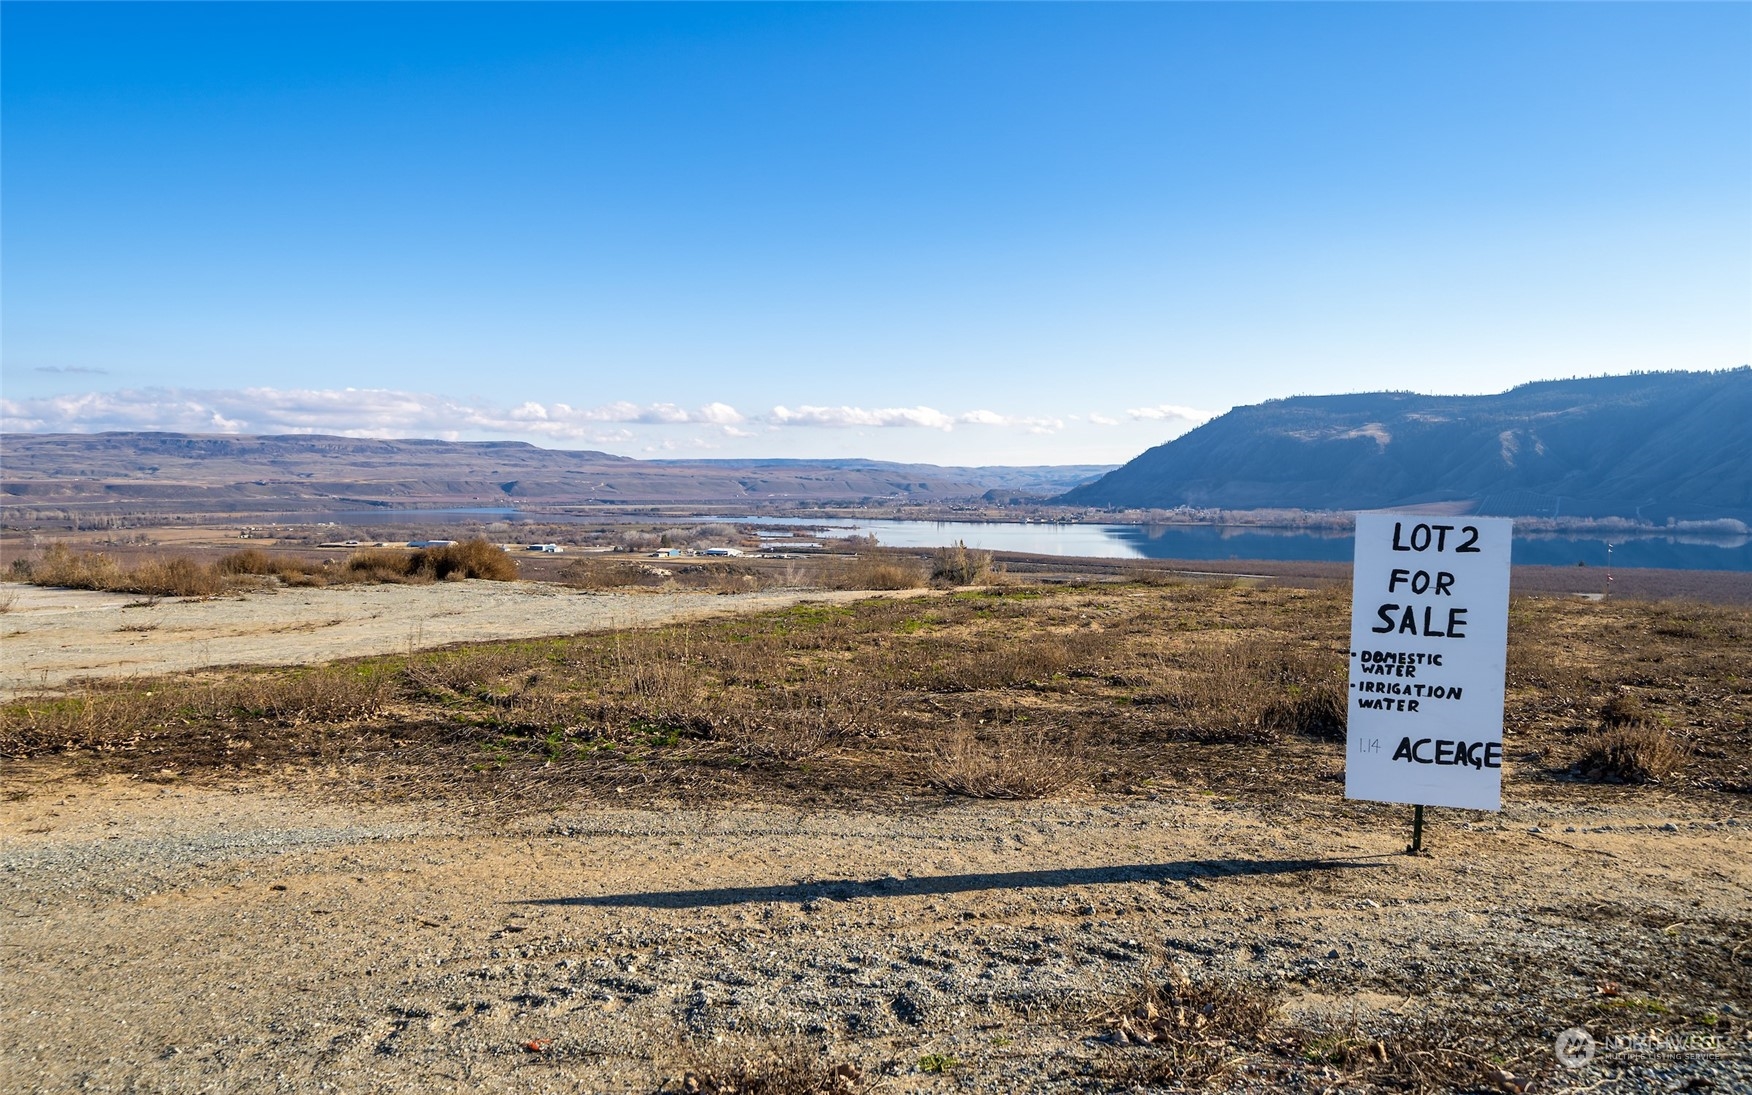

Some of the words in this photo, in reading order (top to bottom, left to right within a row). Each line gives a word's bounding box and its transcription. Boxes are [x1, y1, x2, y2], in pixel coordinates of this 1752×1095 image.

[1393, 522, 1454, 553] LOT
[1456, 526, 1481, 553] 2
[1389, 569, 1455, 596] FOR
[1372, 604, 1468, 638] SALE
[1360, 651, 1443, 666] DOMESTIC
[1360, 664, 1416, 678] WATER
[1359, 681, 1463, 700] IRRIGATION
[1358, 699, 1419, 712] WATER
[1359, 738, 1381, 753] 1.14
[1392, 737, 1502, 770] ACEAGE
